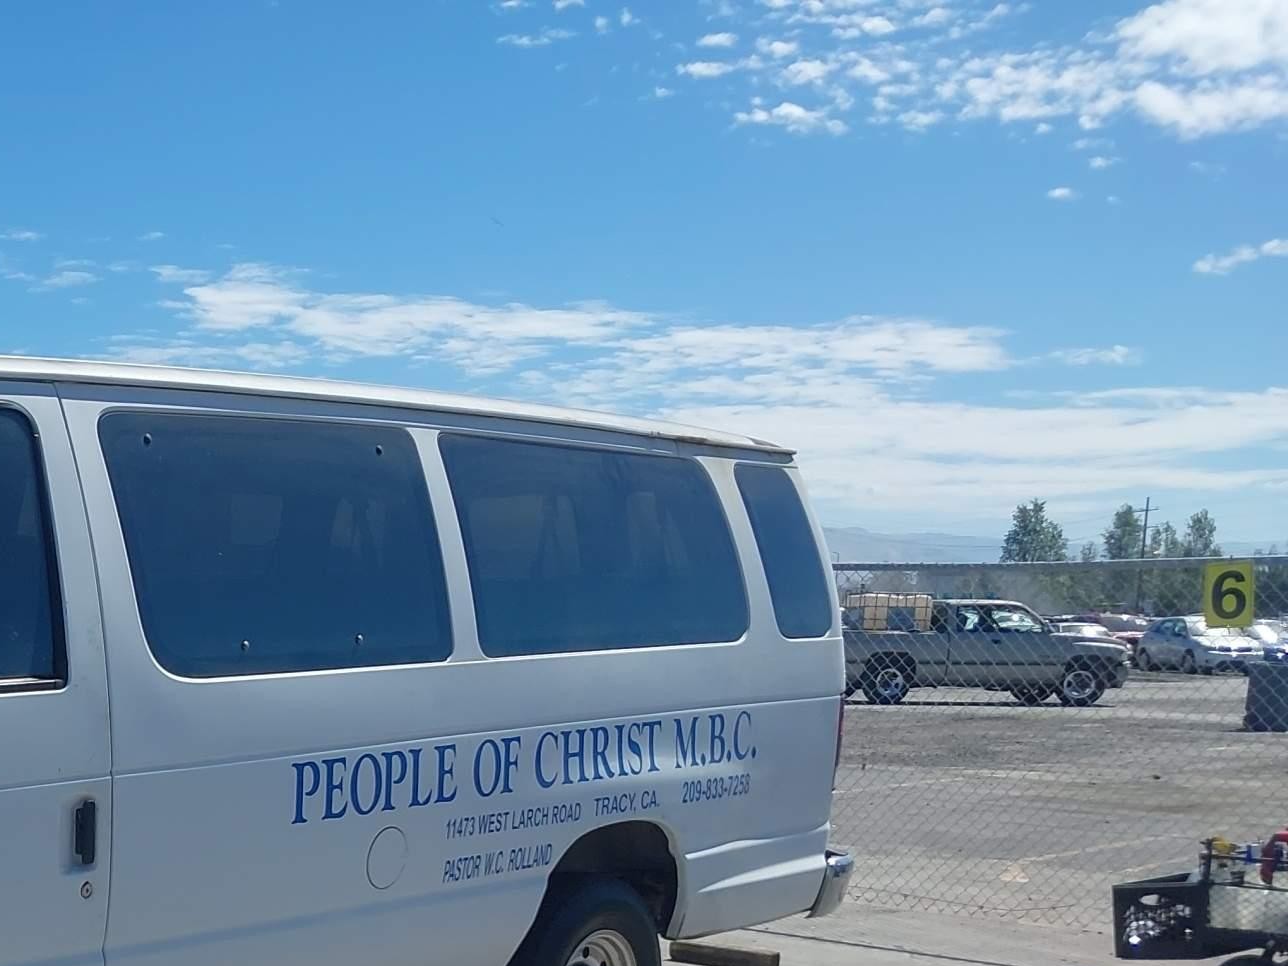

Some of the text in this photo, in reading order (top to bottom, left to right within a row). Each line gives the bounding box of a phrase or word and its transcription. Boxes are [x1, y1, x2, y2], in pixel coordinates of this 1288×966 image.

[1212, 570, 1246, 619] 6
[291, 711, 756, 824] PEOPLE OF CHRIST M.B.C.
[446, 773, 751, 839] 11473 WEST LARCH ROAD TRACY, CA. 209-833-7258
[442, 844, 552, 883] PASTOR W.C. ROLLAND
